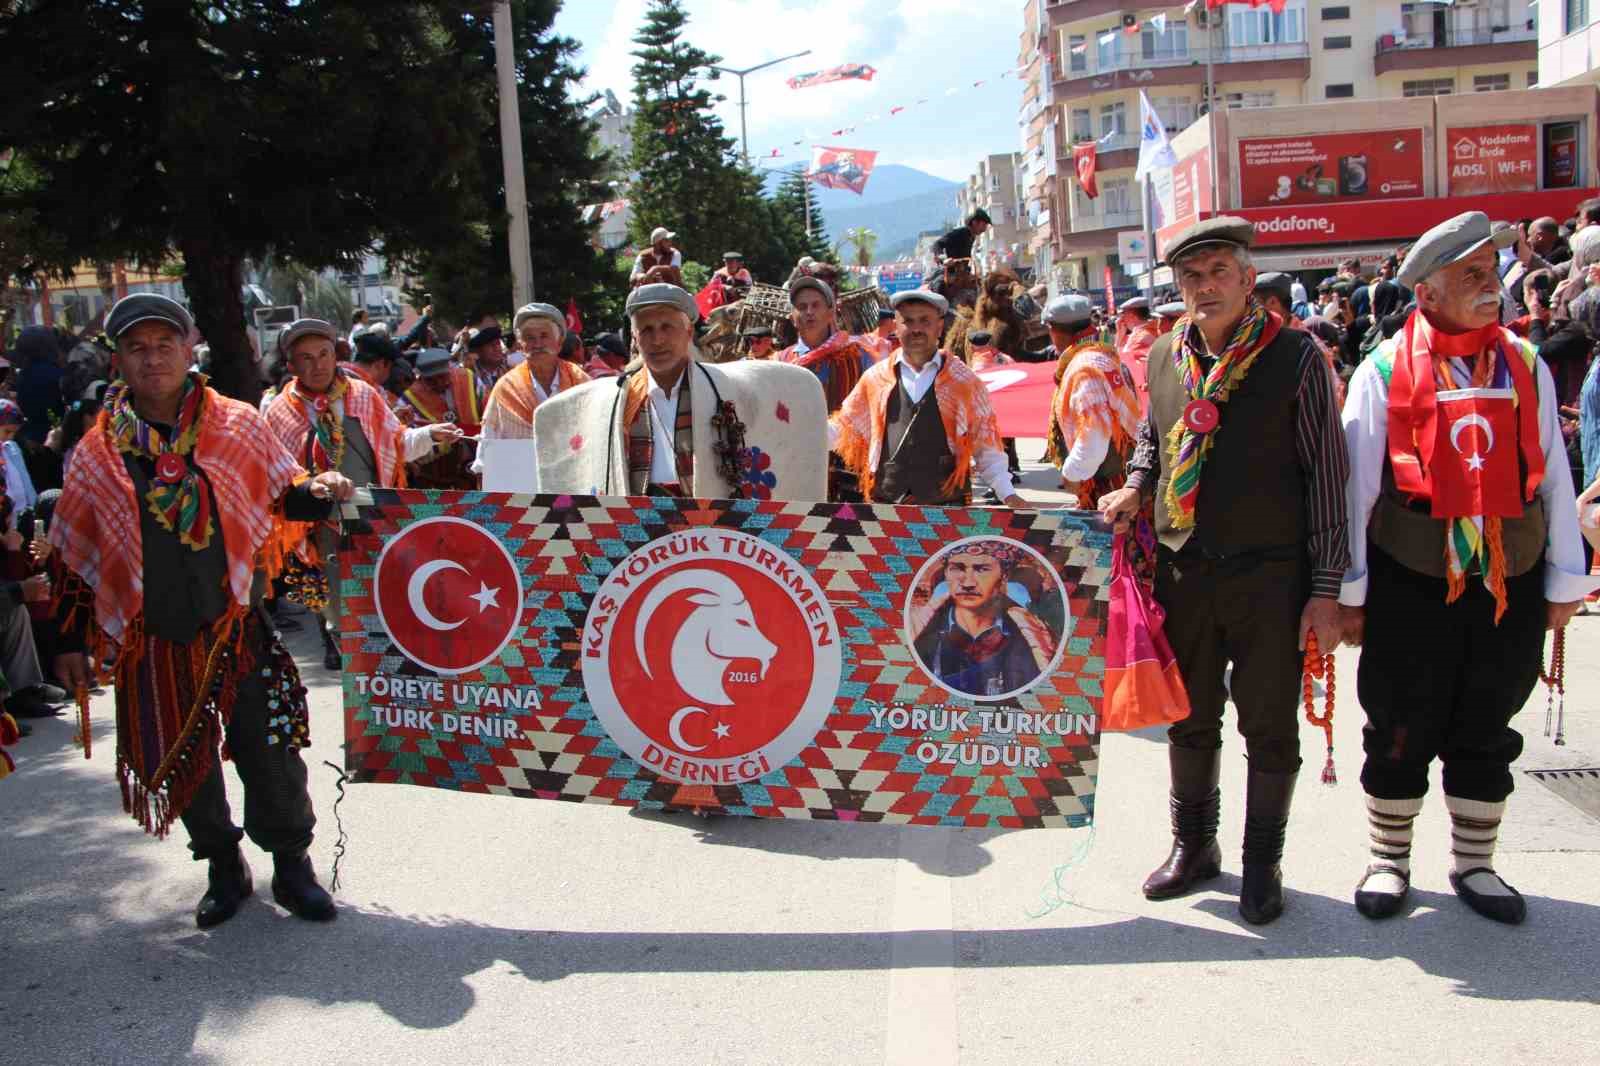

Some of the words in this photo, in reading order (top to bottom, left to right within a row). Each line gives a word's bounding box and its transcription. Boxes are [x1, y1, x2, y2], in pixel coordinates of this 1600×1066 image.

[1480, 134, 1530, 145] Vodafone
[1480, 147, 1505, 157] Evde
[1452, 163, 1486, 177] ADSL
[586, 594, 618, 658] KAŞ
[612, 534, 710, 588] YÖRÜK
[719, 536, 833, 647] TÜRKMEN
[355, 671, 445, 702] TÖREYE
[452, 684, 543, 711] UYANA
[728, 671, 757, 683] 2016
[371, 702, 436, 732] TÜRK
[441, 712, 527, 741] DENİR.
[869, 701, 969, 733] YÖRÜK
[978, 705, 1097, 736] TÜRKÜN
[641, 743, 770, 783] DERNEĞİ
[915, 736, 1049, 770] ÖZÜDÜR.
